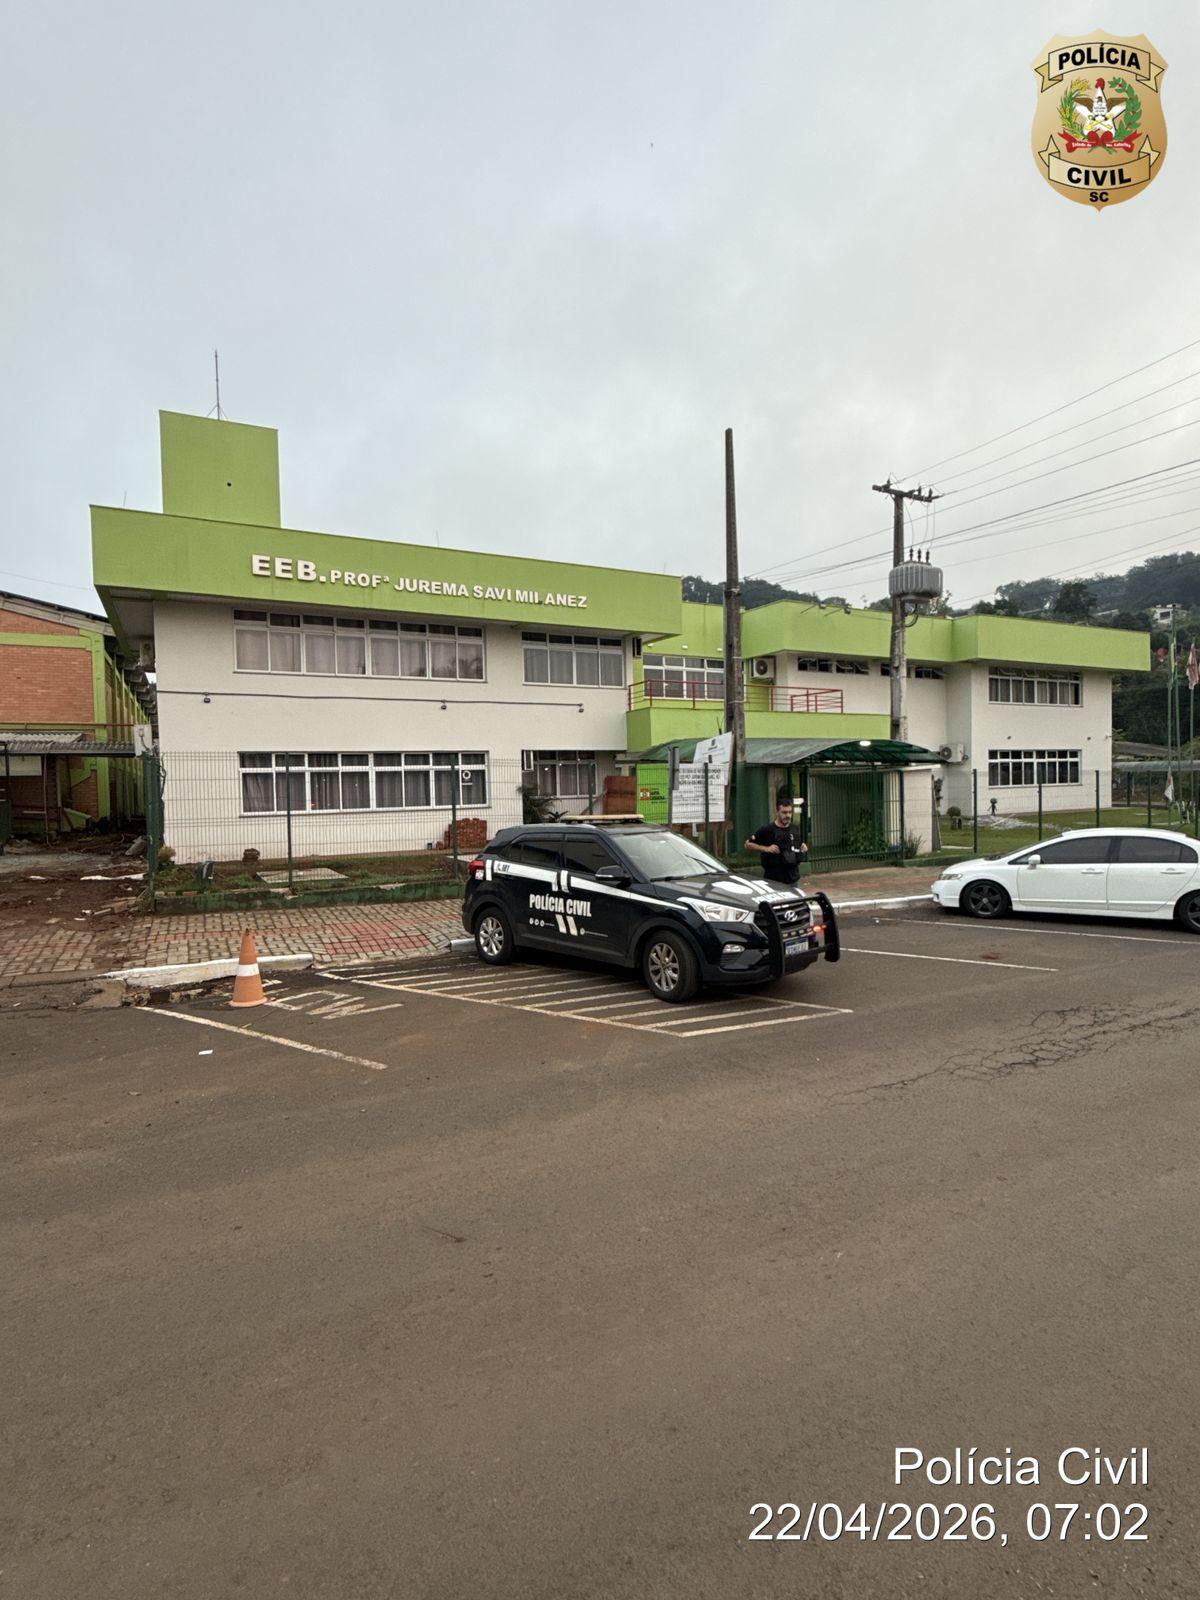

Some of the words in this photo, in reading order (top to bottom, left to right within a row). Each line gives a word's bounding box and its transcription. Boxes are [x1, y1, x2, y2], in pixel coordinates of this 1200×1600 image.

[251, 554, 327, 582] EEB.
[394, 577, 469, 598] JUREMA
[473, 585, 512, 602] SAVI
[515, 589, 588, 609] MILANEZ
[529, 893, 565, 914] POLÍCIA
[566, 898, 592, 917] CIVIL
